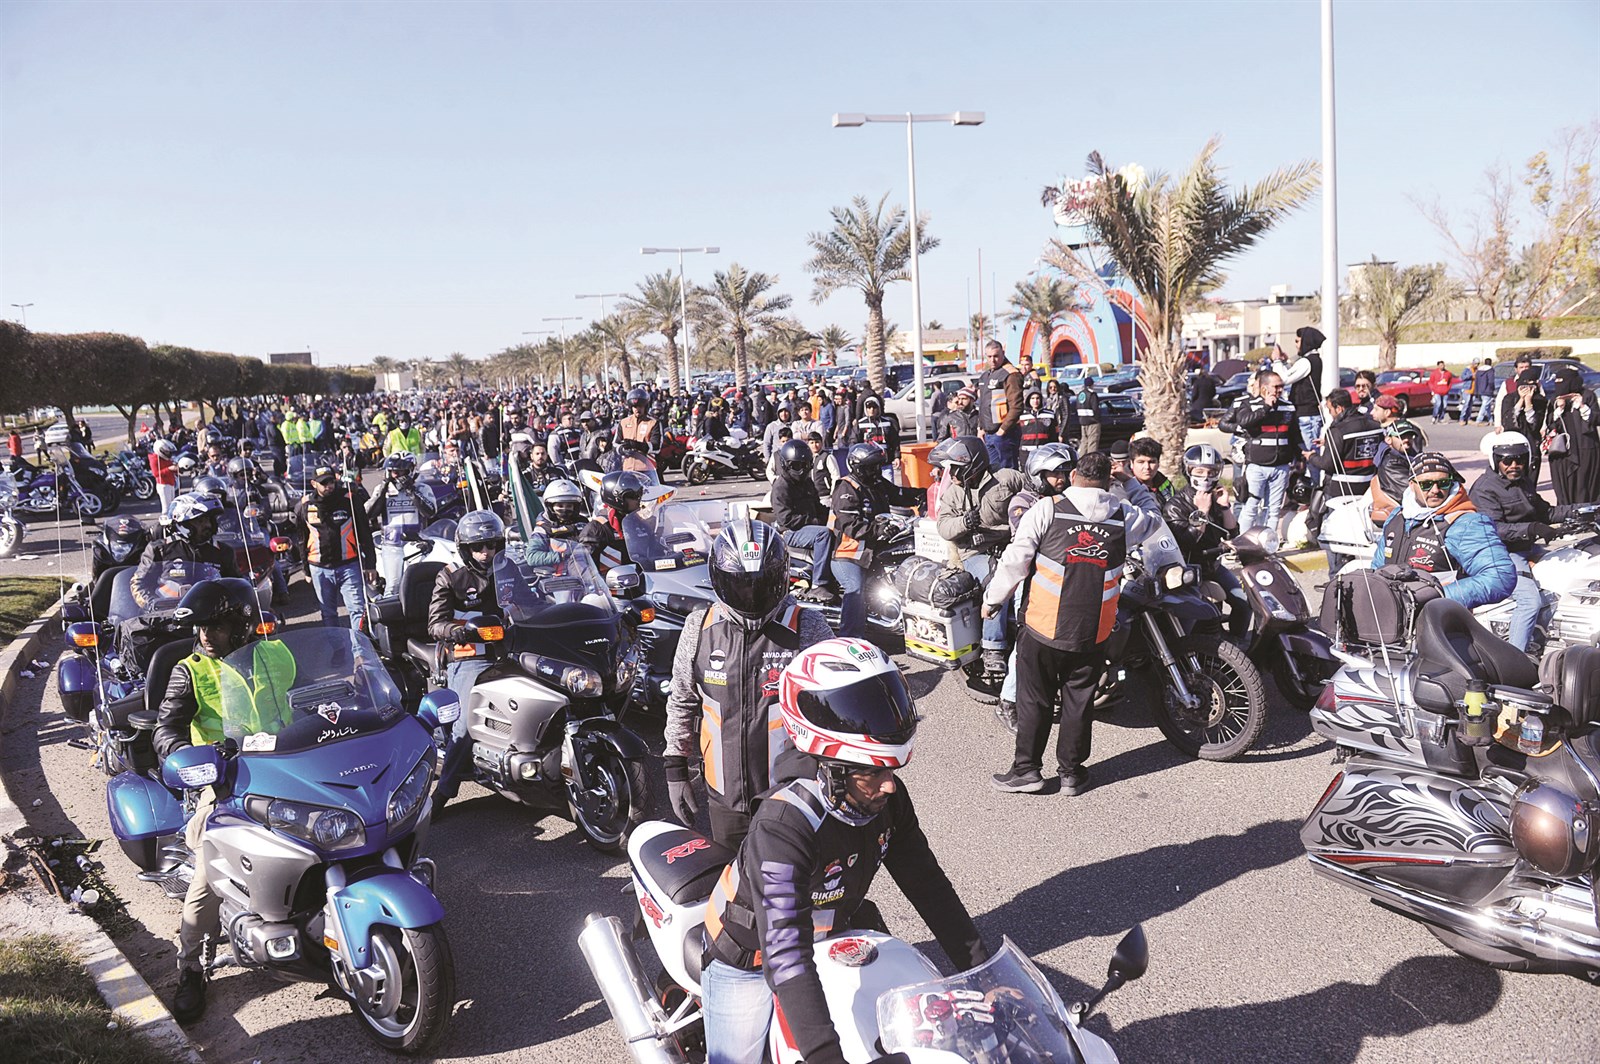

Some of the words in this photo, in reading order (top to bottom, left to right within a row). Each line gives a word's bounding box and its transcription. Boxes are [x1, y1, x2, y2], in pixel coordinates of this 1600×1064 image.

[1066, 524, 1111, 540] KUWAIT
[1411, 543, 1437, 554] KUWAIT
[704, 670, 727, 679] BIKERS
[339, 763, 378, 777] HONDA
[660, 838, 711, 864] RR
[811, 885, 845, 900] BIKERS
[760, 860, 806, 986] MILAN
